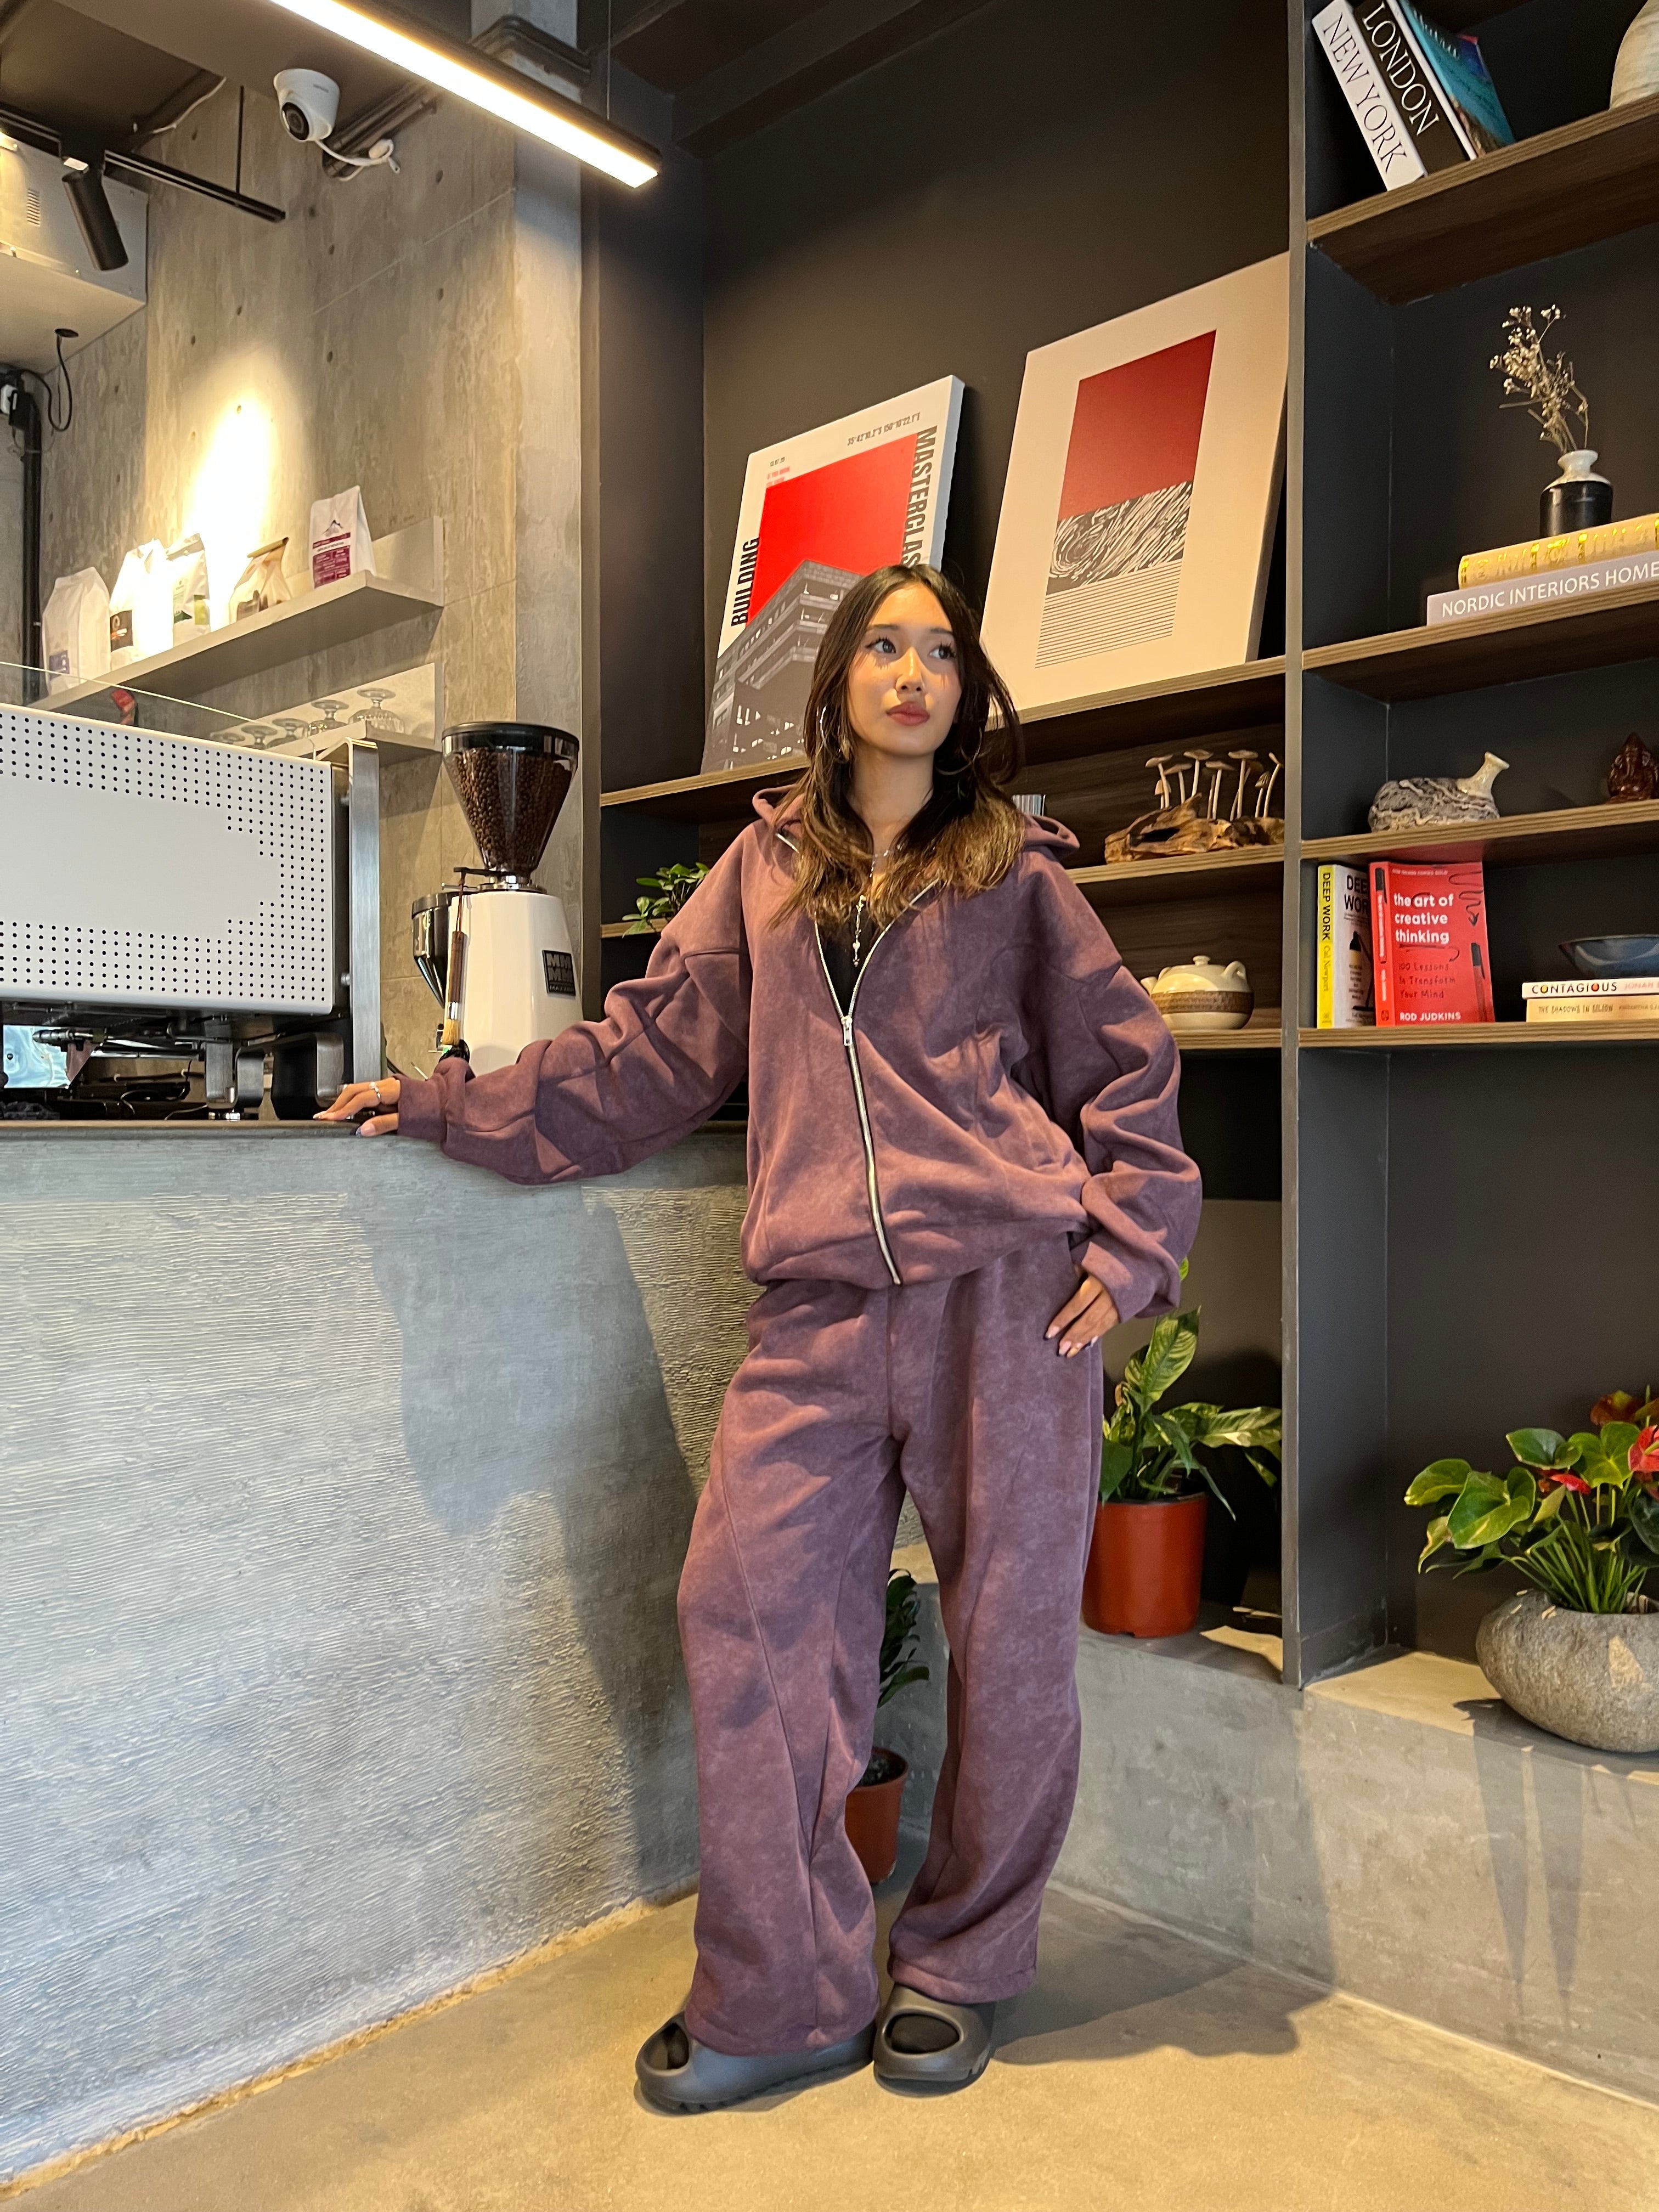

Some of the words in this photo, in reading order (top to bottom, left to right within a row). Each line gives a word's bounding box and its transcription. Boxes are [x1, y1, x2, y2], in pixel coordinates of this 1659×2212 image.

[1362, 1, 1440, 136] LONDON
[1323, 12, 1370, 84] NEW
[1356, 82, 1407, 174] YORK
[731, 537, 760, 627] BUILDING
[1442, 591, 1505, 618] NORDIC
[1510, 573, 1600, 605] INTERIORS
[1605, 561, 1659, 586] HOME
[1394, 893, 1411, 907] the
[1414, 895, 1435, 907] art
[1438, 893, 1454, 907] of
[1322, 905, 1330, 941] WORK
[1395, 912, 1448, 925] creative
[1396, 929, 1449, 945] thinking
[1414, 962, 1449, 972] Lessons
[1409, 975, 1455, 985] Transform
[1400, 989, 1417, 998] Your
[1421, 989, 1444, 998] Mind
[1532, 981, 1617, 994] CONTAGIOUS
[1400, 1012, 1417, 1021] ROD
[1420, 1011, 1461, 1021] JUDKINS
